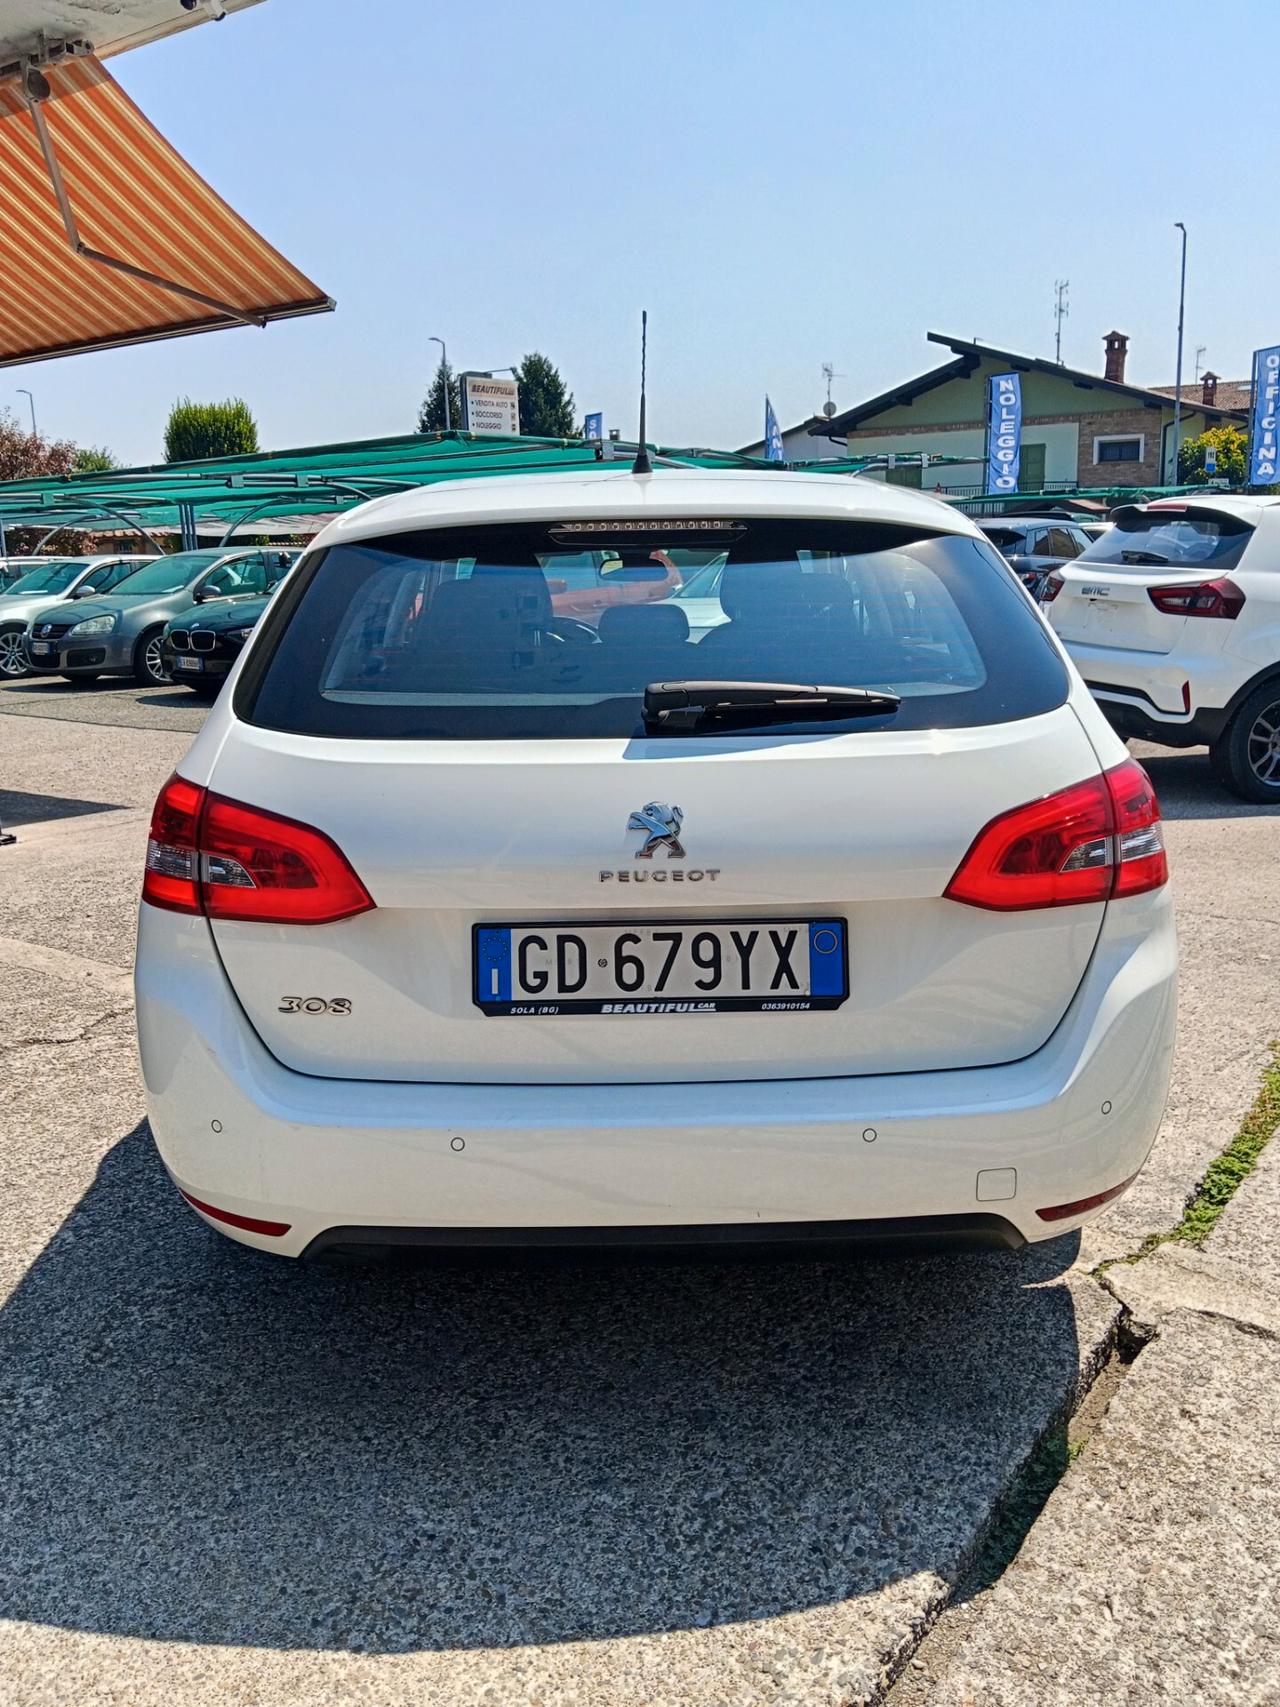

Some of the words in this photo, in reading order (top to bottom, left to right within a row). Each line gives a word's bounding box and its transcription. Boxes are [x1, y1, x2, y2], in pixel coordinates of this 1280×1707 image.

[472, 384, 509, 395] BEAUTIFUL
[1257, 355, 1280, 475] OFFICINA
[995, 379, 1017, 490] NOLEGGIO
[599, 869, 721, 883] PEUGEOT
[518, 933, 588, 995] GD
[614, 929, 800, 993] 679YX
[278, 996, 352, 1016] 308
[510, 1006, 535, 1015] SOLA
[538, 1006, 559, 1015] (BG)
[761, 1002, 811, 1011] 0363910154
